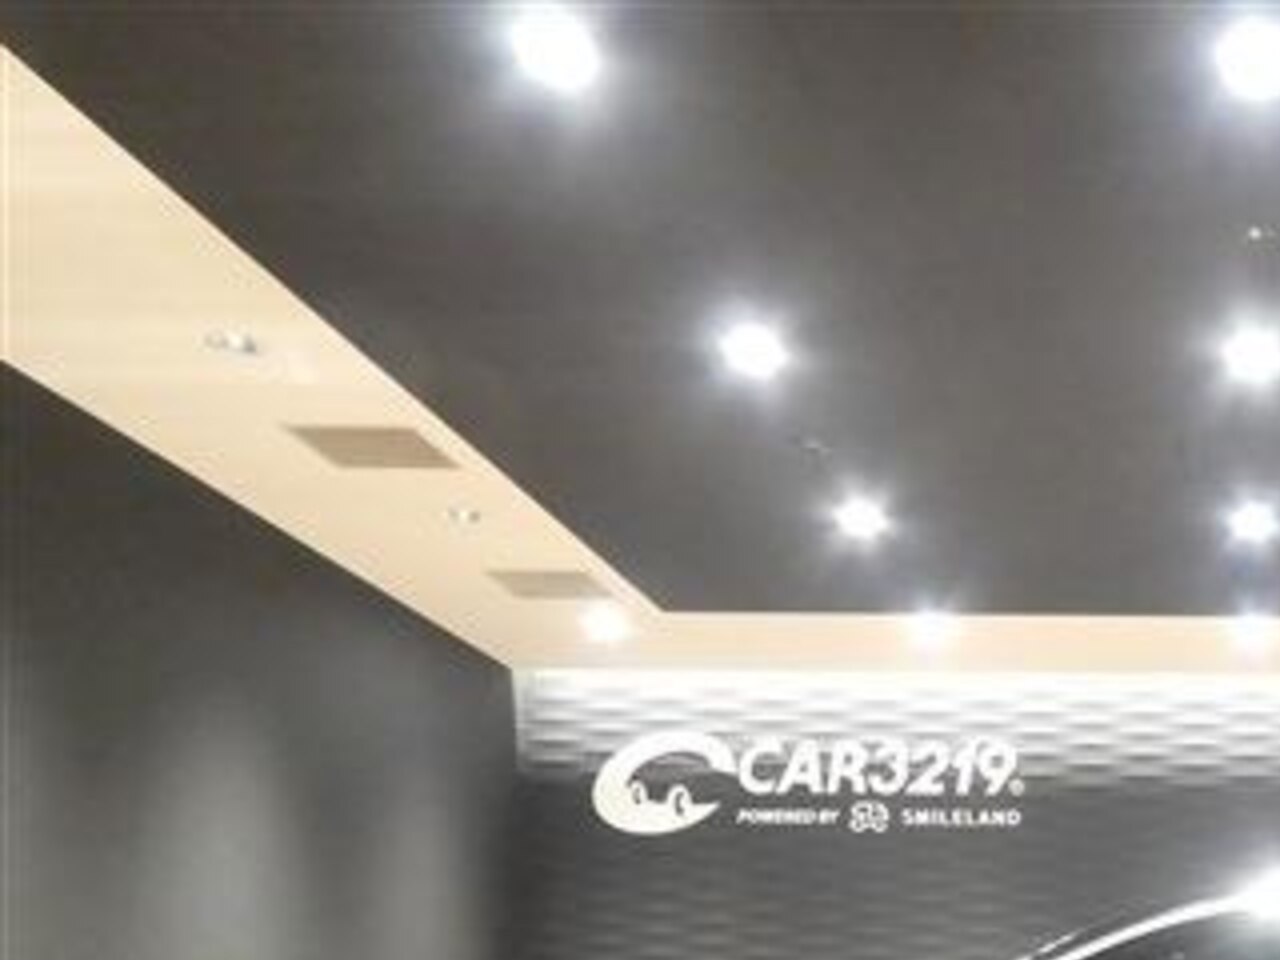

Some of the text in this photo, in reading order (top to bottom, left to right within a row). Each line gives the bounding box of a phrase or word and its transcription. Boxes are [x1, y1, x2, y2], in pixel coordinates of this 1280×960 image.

[739, 738, 1018, 796] CAR3219
[736, 808, 1021, 826] POWERED BY SMILELAND
